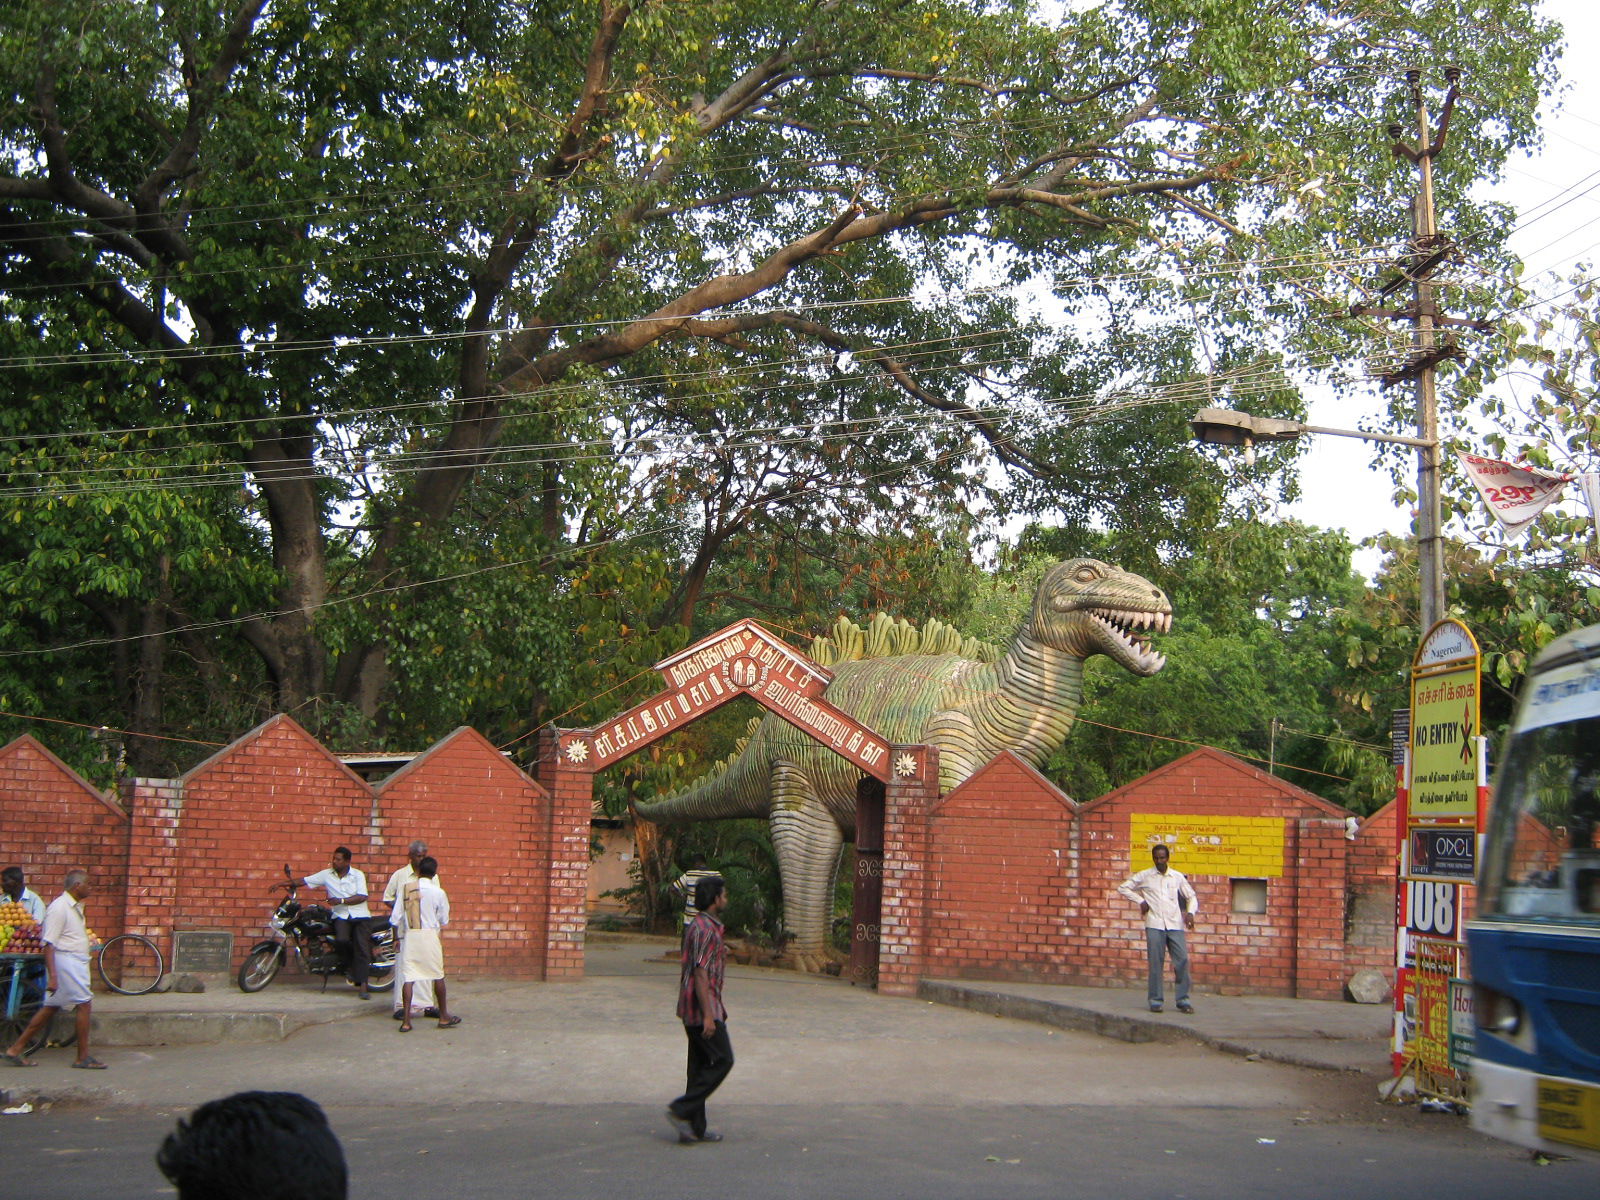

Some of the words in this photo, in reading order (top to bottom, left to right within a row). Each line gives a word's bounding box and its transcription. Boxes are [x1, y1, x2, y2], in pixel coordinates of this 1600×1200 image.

[1417, 681, 1475, 706] எச்சரிக்கை
[1416, 725, 1427, 747] NO
[1430, 721, 1458, 745] ENTRY
[1406, 881, 1453, 934] 108
